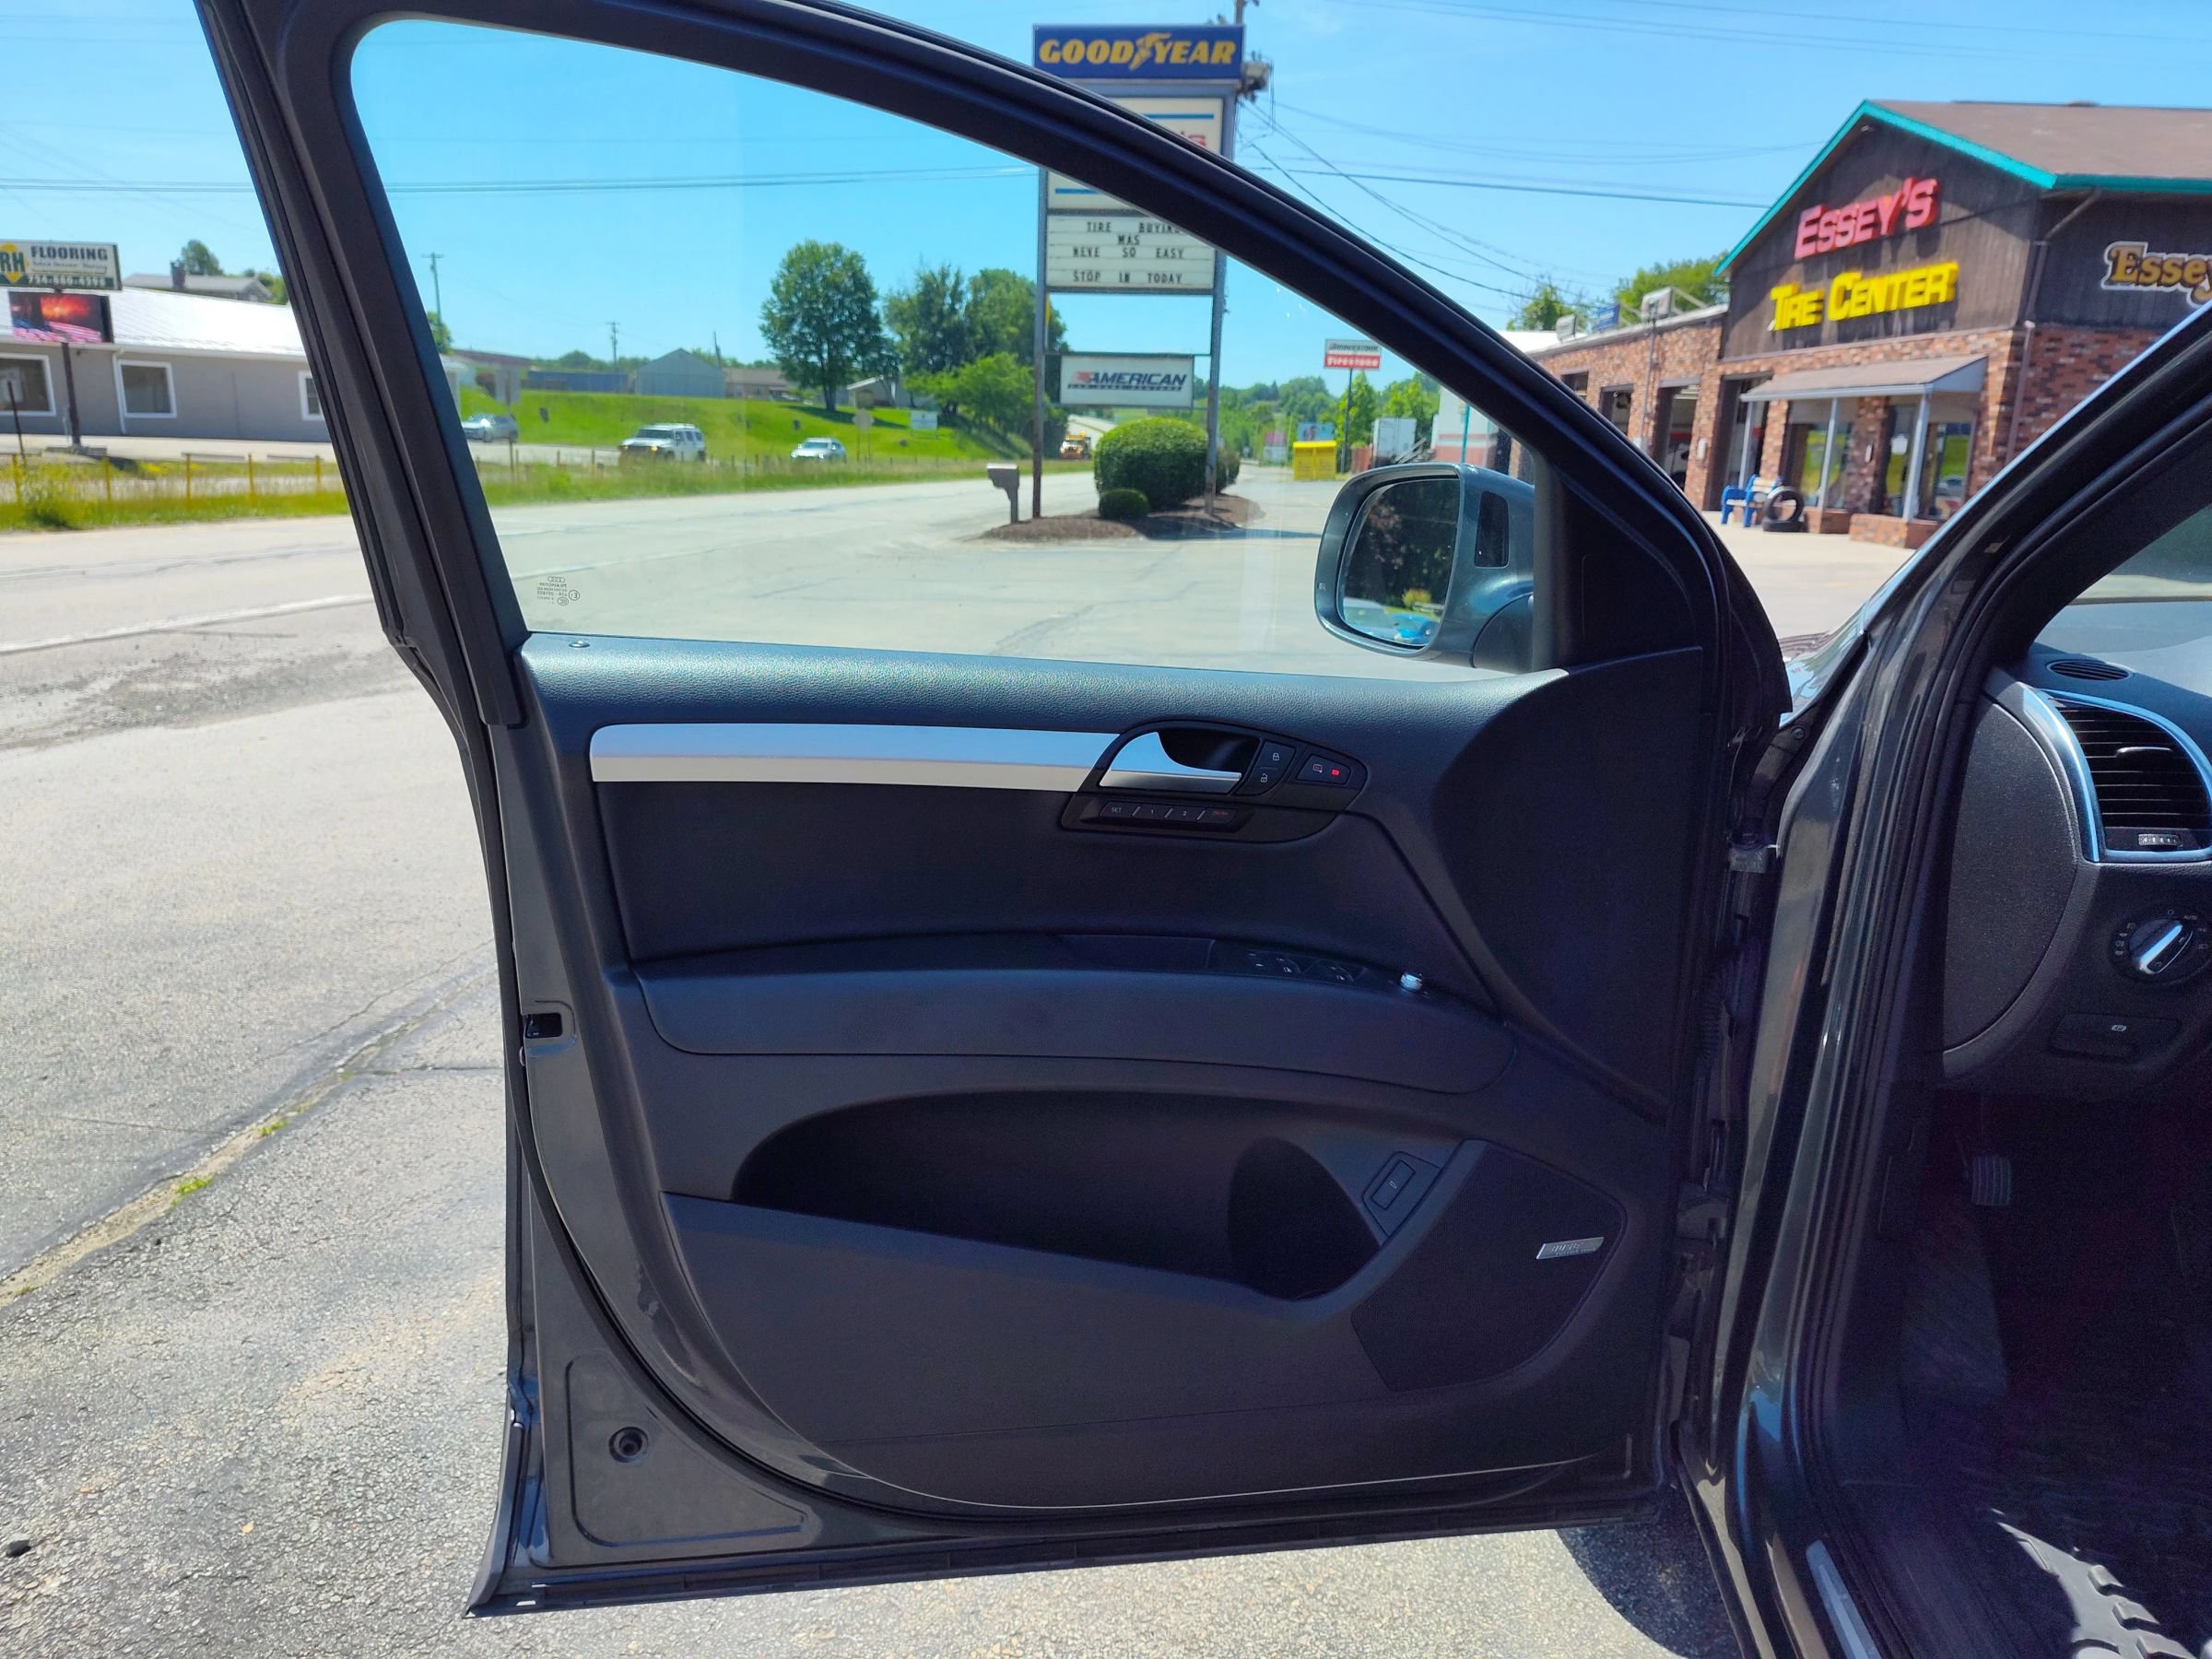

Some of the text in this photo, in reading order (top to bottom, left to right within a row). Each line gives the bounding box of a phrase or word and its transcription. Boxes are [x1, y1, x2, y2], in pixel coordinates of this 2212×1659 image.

[1039, 34, 1237, 70] GOODYEAR
[1794, 176, 1940, 260] ESSEY'S
[1087, 221, 1181, 233] TIRE BUYIN
[30, 245, 109, 261] FLOORING
[1122, 247, 1136, 258] SO
[1156, 247, 1184, 259] EASY
[1073, 270, 1182, 284] STOP IN TODAY
[1770, 260, 1959, 332] TIRE CENTER
[1087, 371, 1187, 386] AMERICAN
